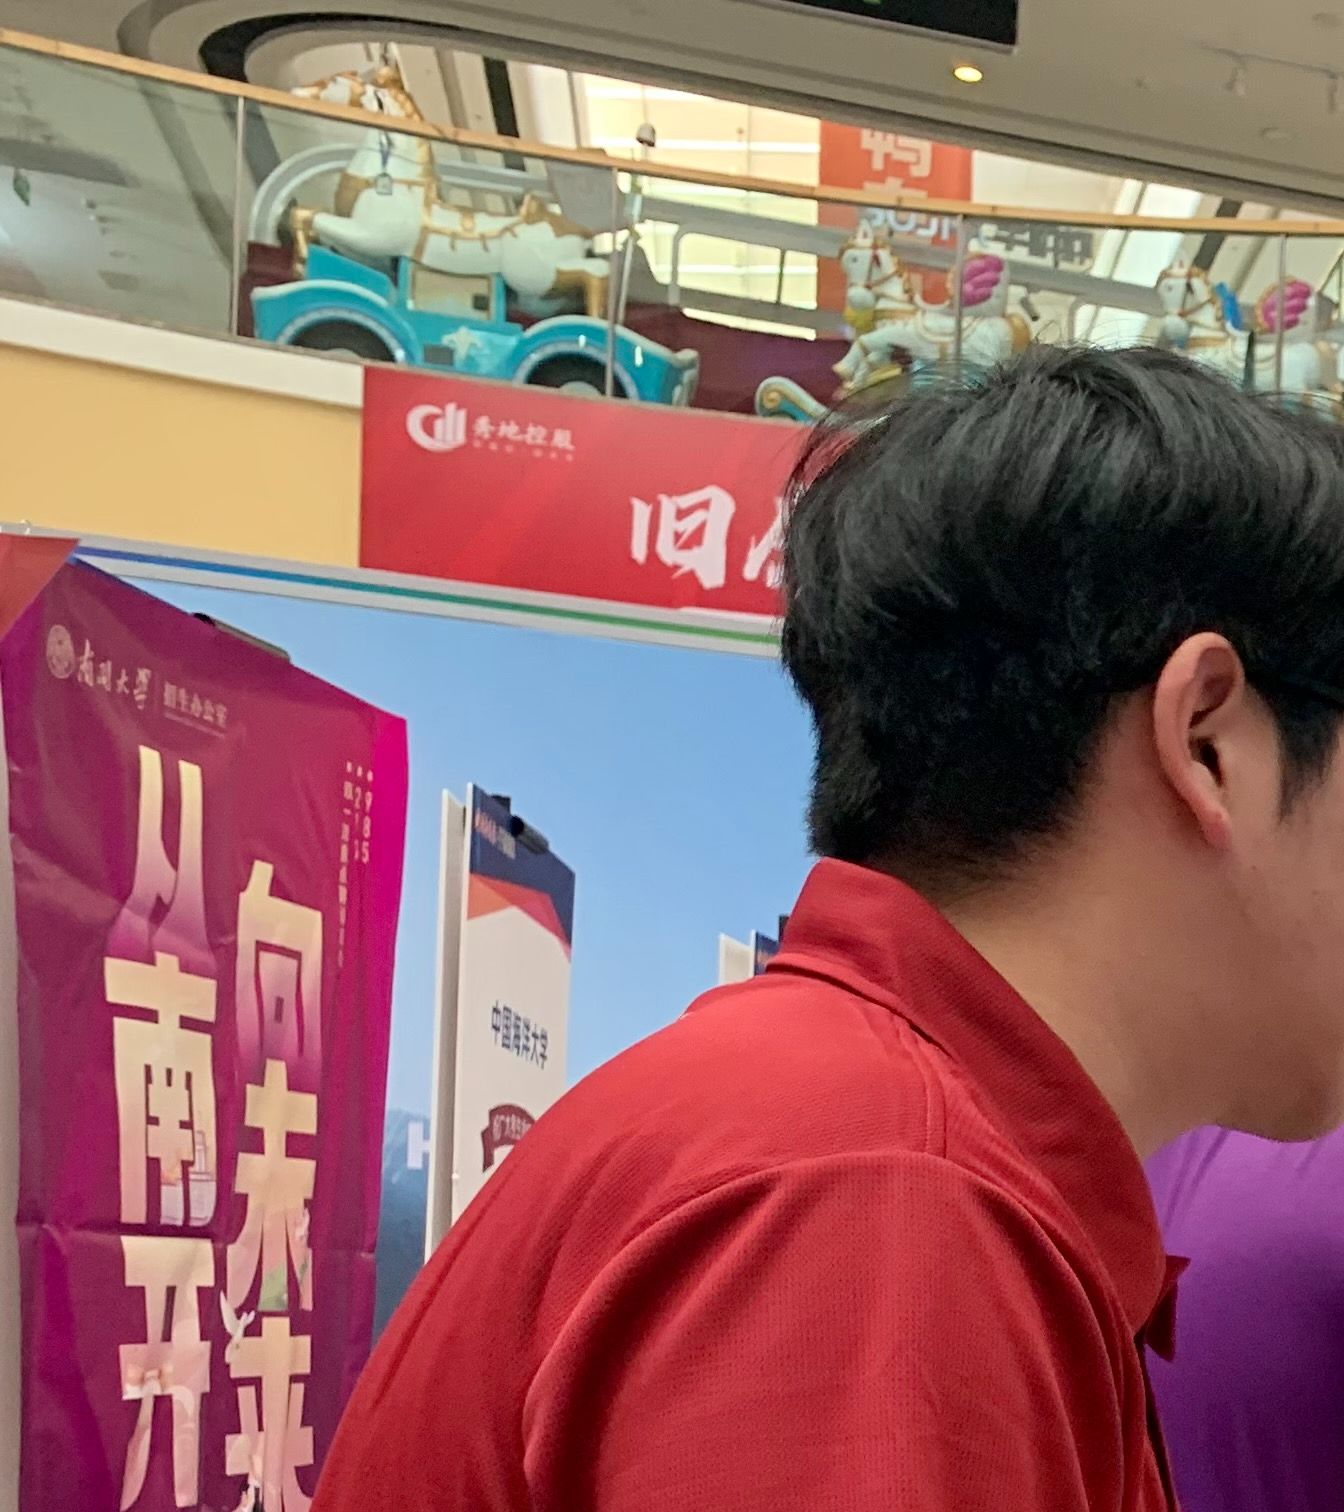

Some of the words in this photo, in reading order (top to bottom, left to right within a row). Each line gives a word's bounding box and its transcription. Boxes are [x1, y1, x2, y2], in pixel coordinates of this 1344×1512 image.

[104, 745, 217, 1512] 从南开
[491, 1000, 549, 1070] 中国海洋大学
